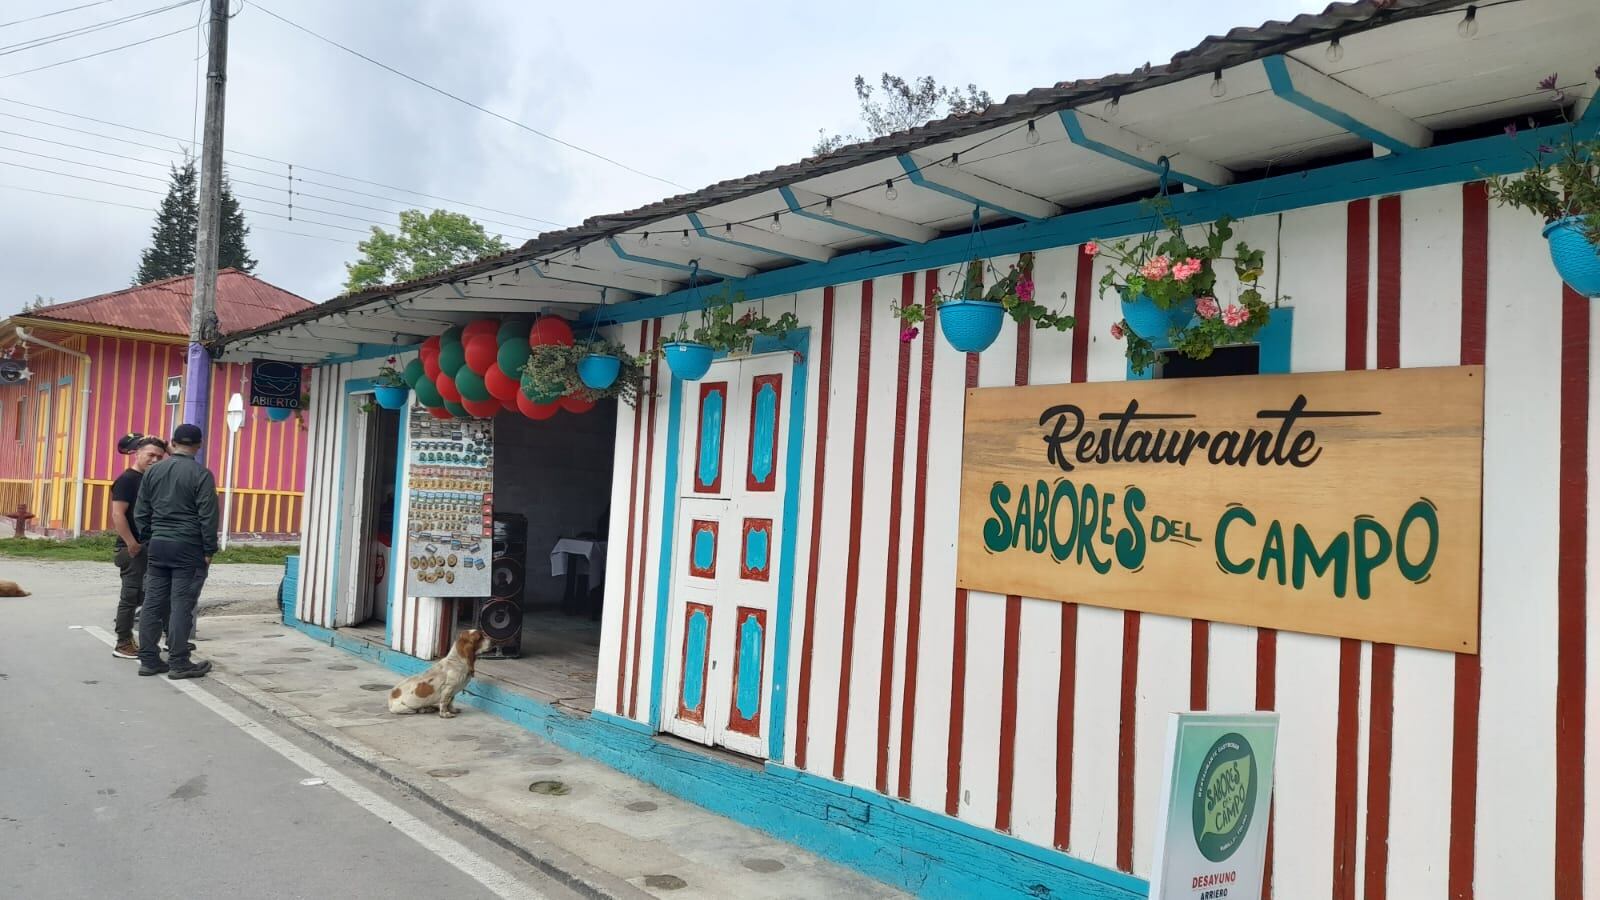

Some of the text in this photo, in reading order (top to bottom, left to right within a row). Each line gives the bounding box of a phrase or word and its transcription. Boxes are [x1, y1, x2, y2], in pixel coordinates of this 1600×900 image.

[252, 395, 298, 408] ABIERTO
[1039, 394, 1382, 472] Restaurante
[983, 479, 1440, 600] SABORES DEL CAMPO
[1207, 761, 1240, 812] SABORES
[1215, 784, 1245, 832] CAMPO
[1192, 870, 1236, 888] DESAYUNO
[1200, 888, 1228, 900] ARRIERO
